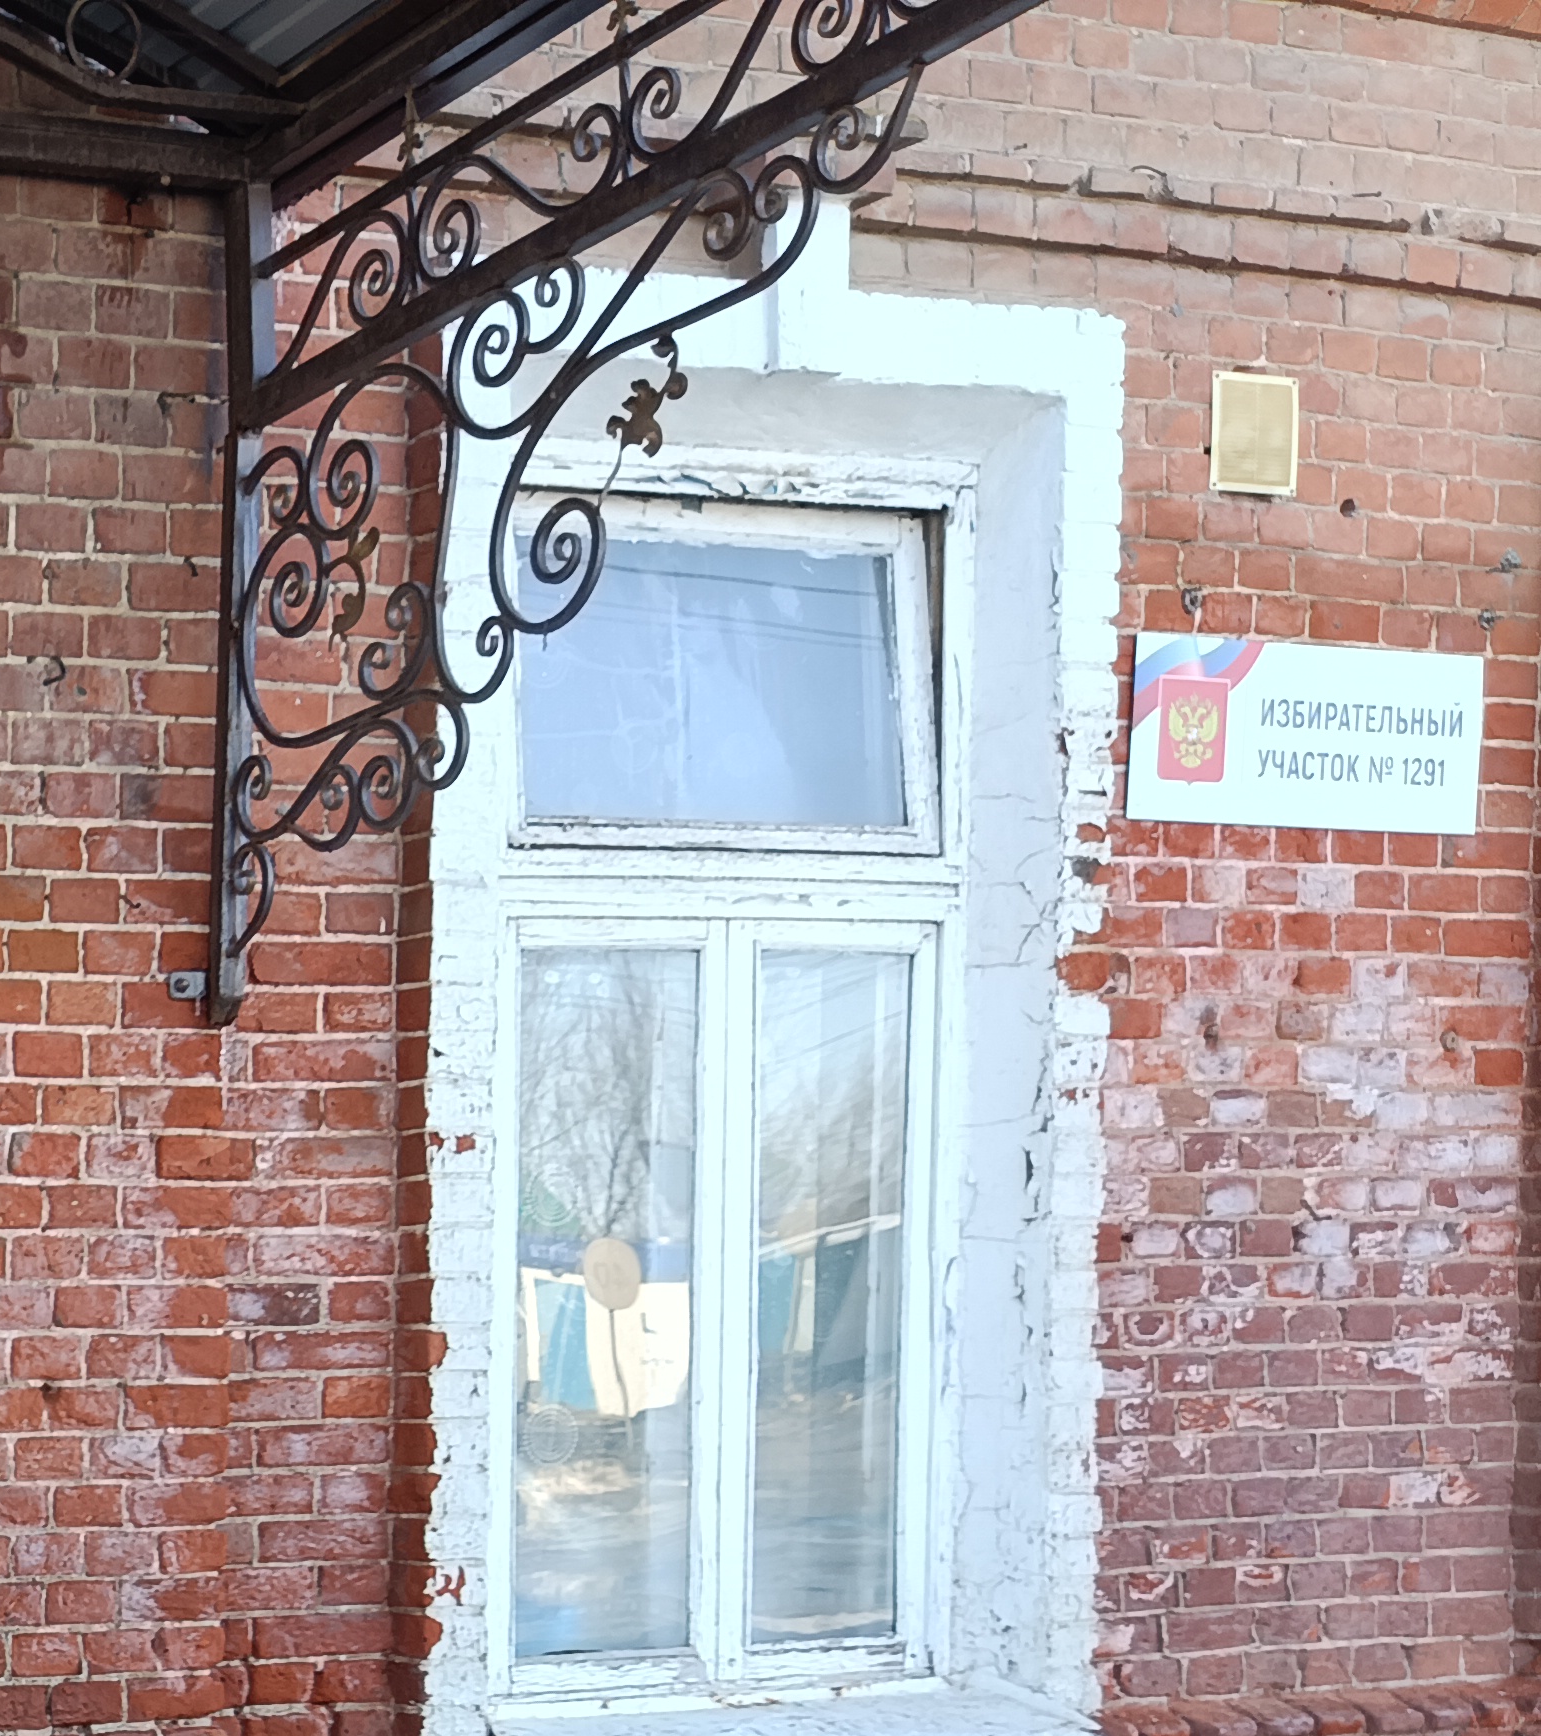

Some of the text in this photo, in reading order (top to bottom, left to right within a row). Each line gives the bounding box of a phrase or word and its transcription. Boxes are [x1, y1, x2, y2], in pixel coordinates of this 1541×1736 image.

[1260, 698, 1463, 738] ИЗБИРАТЕЛЬНЫЙ
[1257, 749, 1445, 787] УЧАСТОК № 1291
